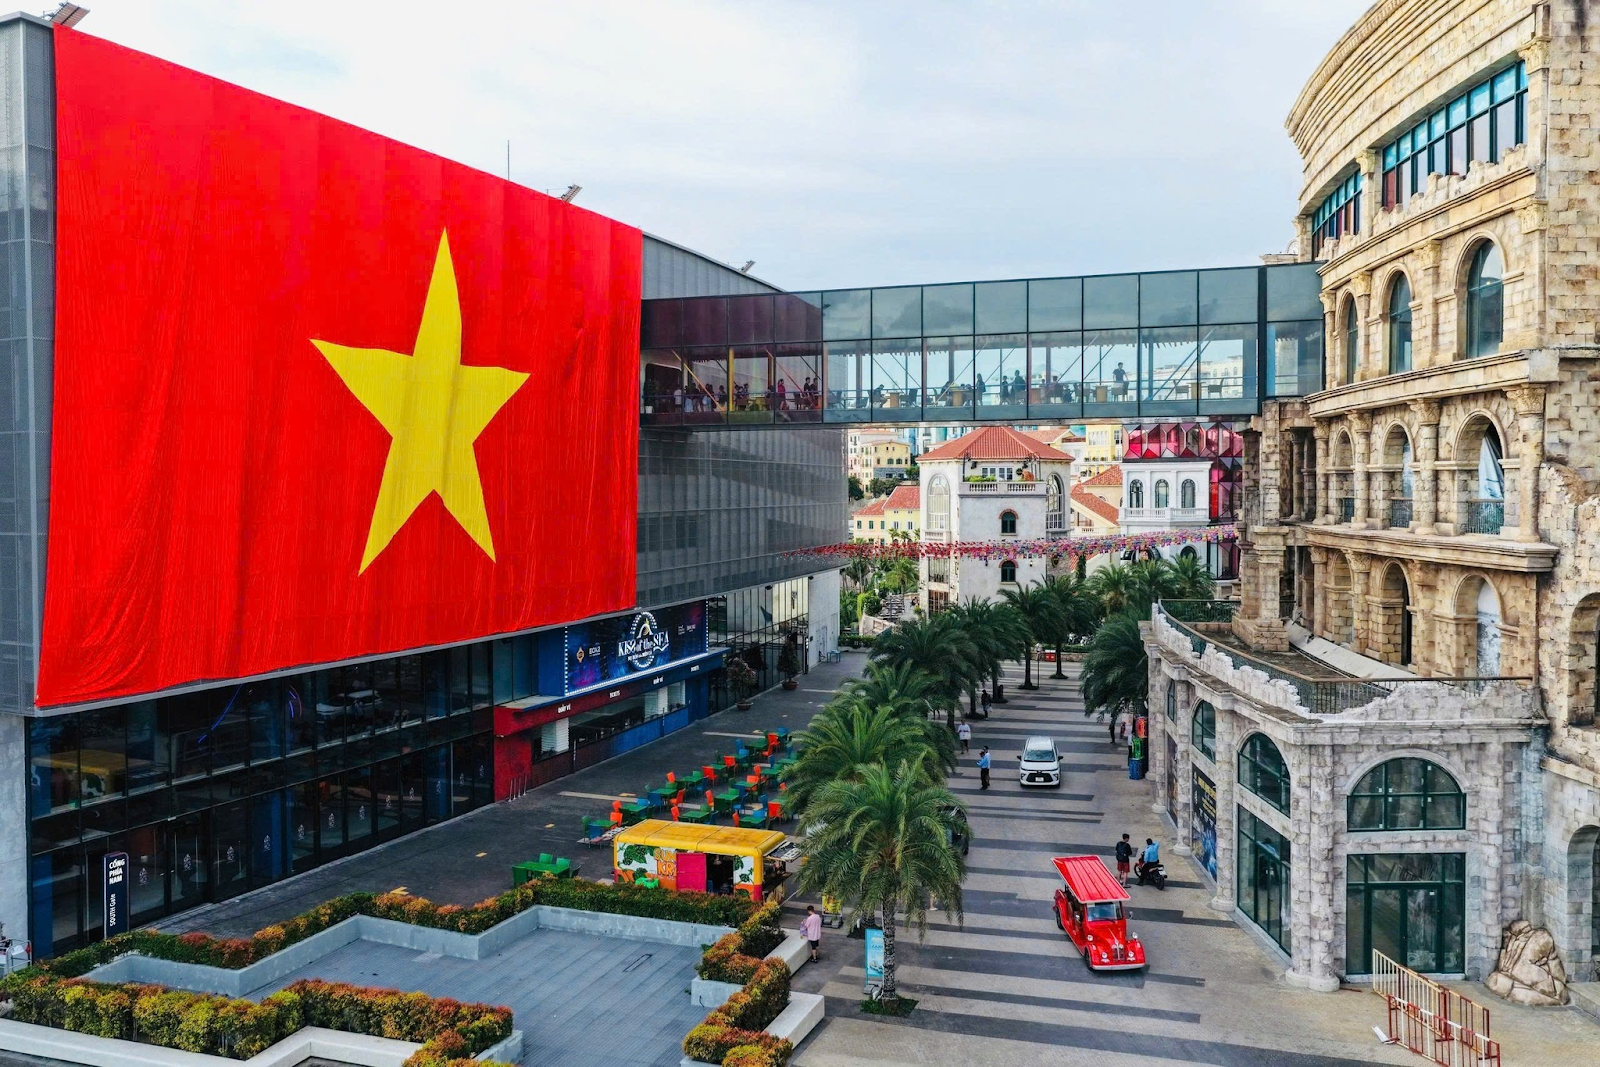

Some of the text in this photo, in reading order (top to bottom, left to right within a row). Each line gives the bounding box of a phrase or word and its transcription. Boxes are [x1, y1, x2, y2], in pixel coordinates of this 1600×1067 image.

[653, 631, 669, 647] SEA
[109, 867, 123, 877] PHÍA
[109, 875, 122, 885] NAM
